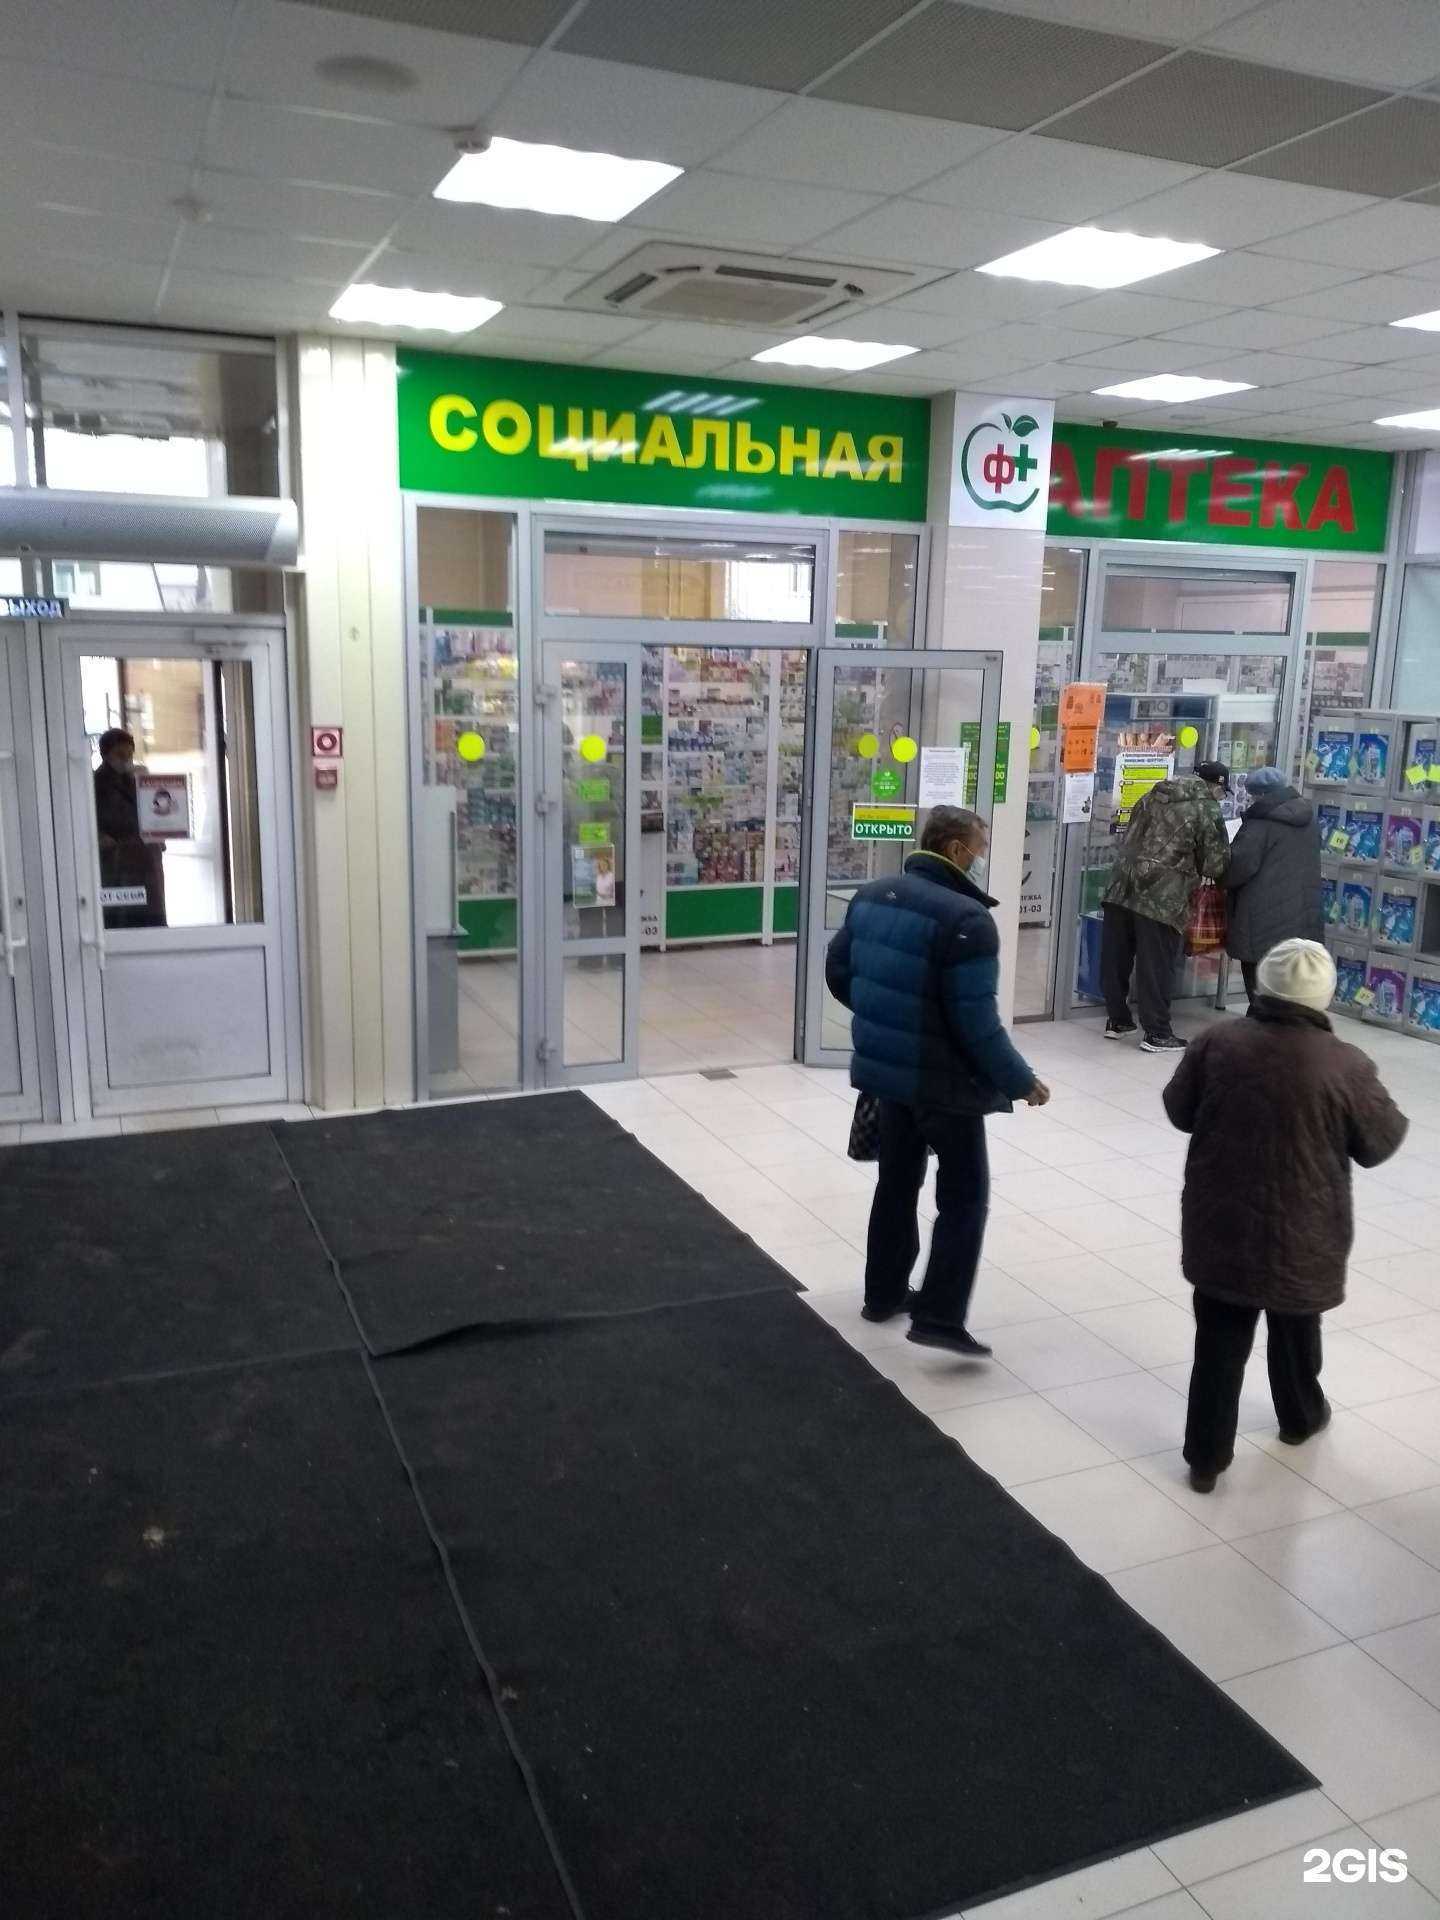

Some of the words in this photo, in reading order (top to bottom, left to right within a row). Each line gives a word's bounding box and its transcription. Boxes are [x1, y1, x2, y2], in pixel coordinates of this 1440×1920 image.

[428, 394, 905, 483] СОЦИАЛЬНАЯ
[1047, 442, 1357, 533] АПТЕКА
[855, 823, 913, 836] ОТКРЫТО
